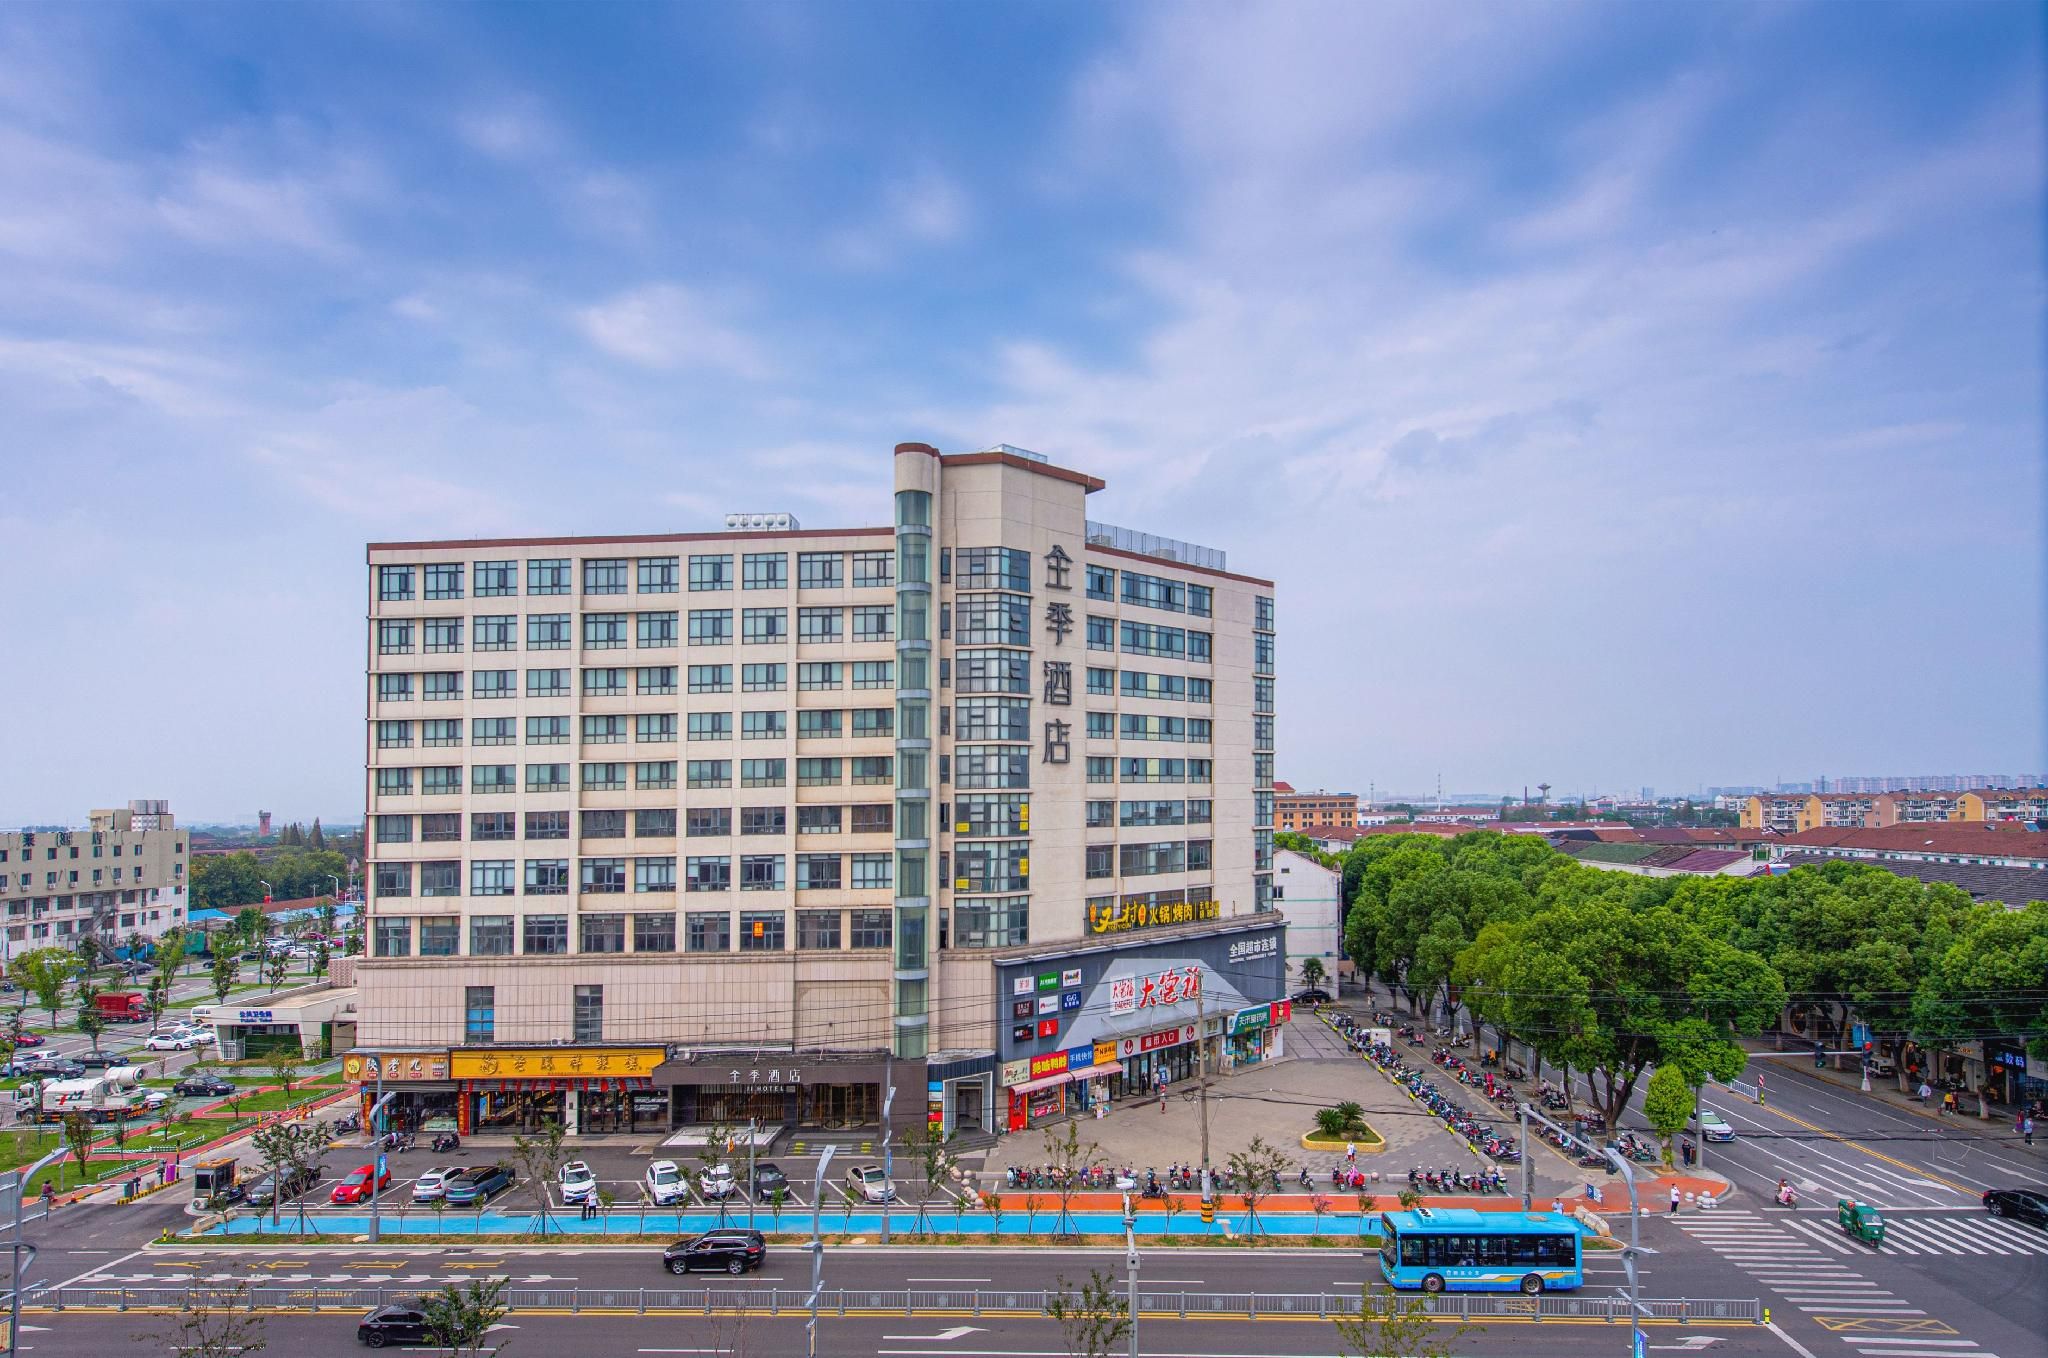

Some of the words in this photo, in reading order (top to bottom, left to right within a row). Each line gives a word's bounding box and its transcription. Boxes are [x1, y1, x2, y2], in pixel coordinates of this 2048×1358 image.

[1042, 544, 1074, 764] 全季酒店
[1229, 936, 1277, 958] 全国超市连锁
[729, 1068, 801, 1084] 全季酒店
